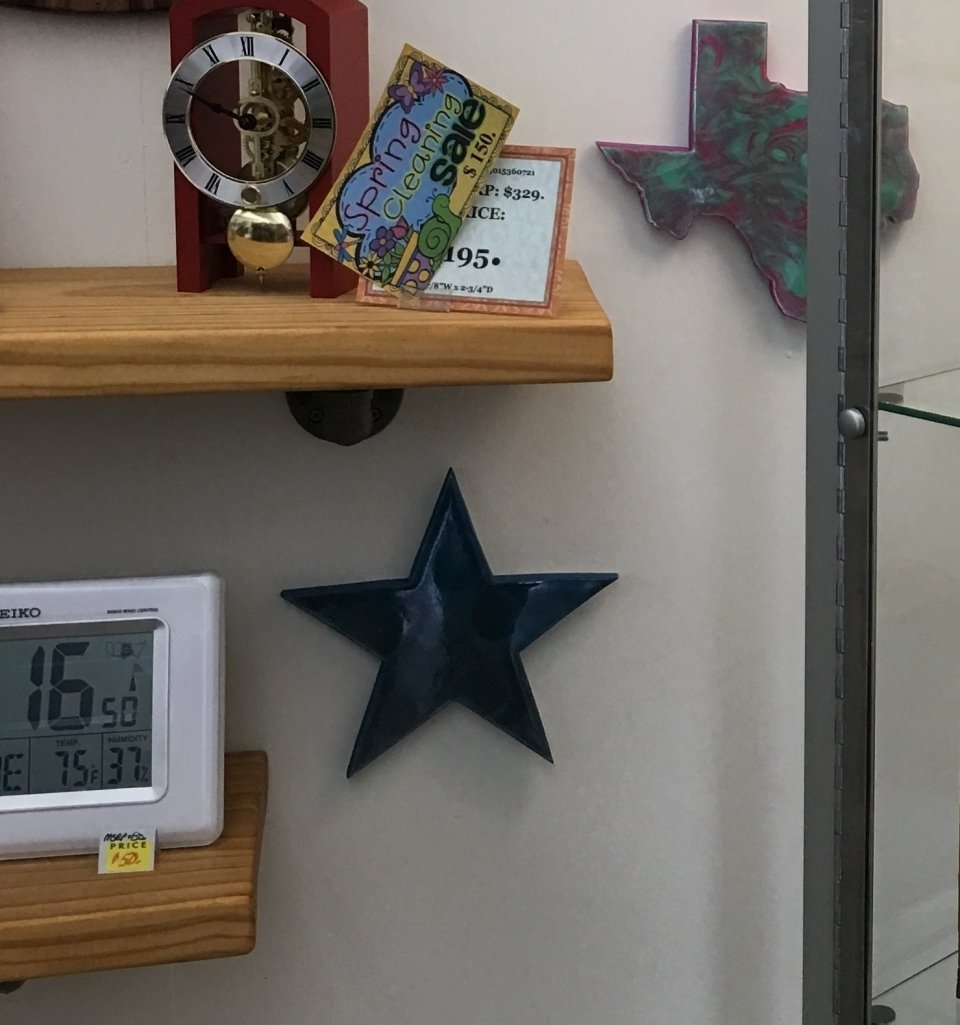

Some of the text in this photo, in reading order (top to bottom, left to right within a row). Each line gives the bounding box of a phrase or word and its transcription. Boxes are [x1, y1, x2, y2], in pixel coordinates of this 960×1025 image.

[240, 37, 255, 57] XII
[384, 93, 463, 219] Cleaning
[430, 98, 486, 187] sale
[344, 117, 421, 230] Spring
[503, 186, 545, 202] $329.
[27, 642, 138, 731] 16 50
[107, 734, 148, 744] HUMIDITY
[110, 841, 147, 850] PRICE
